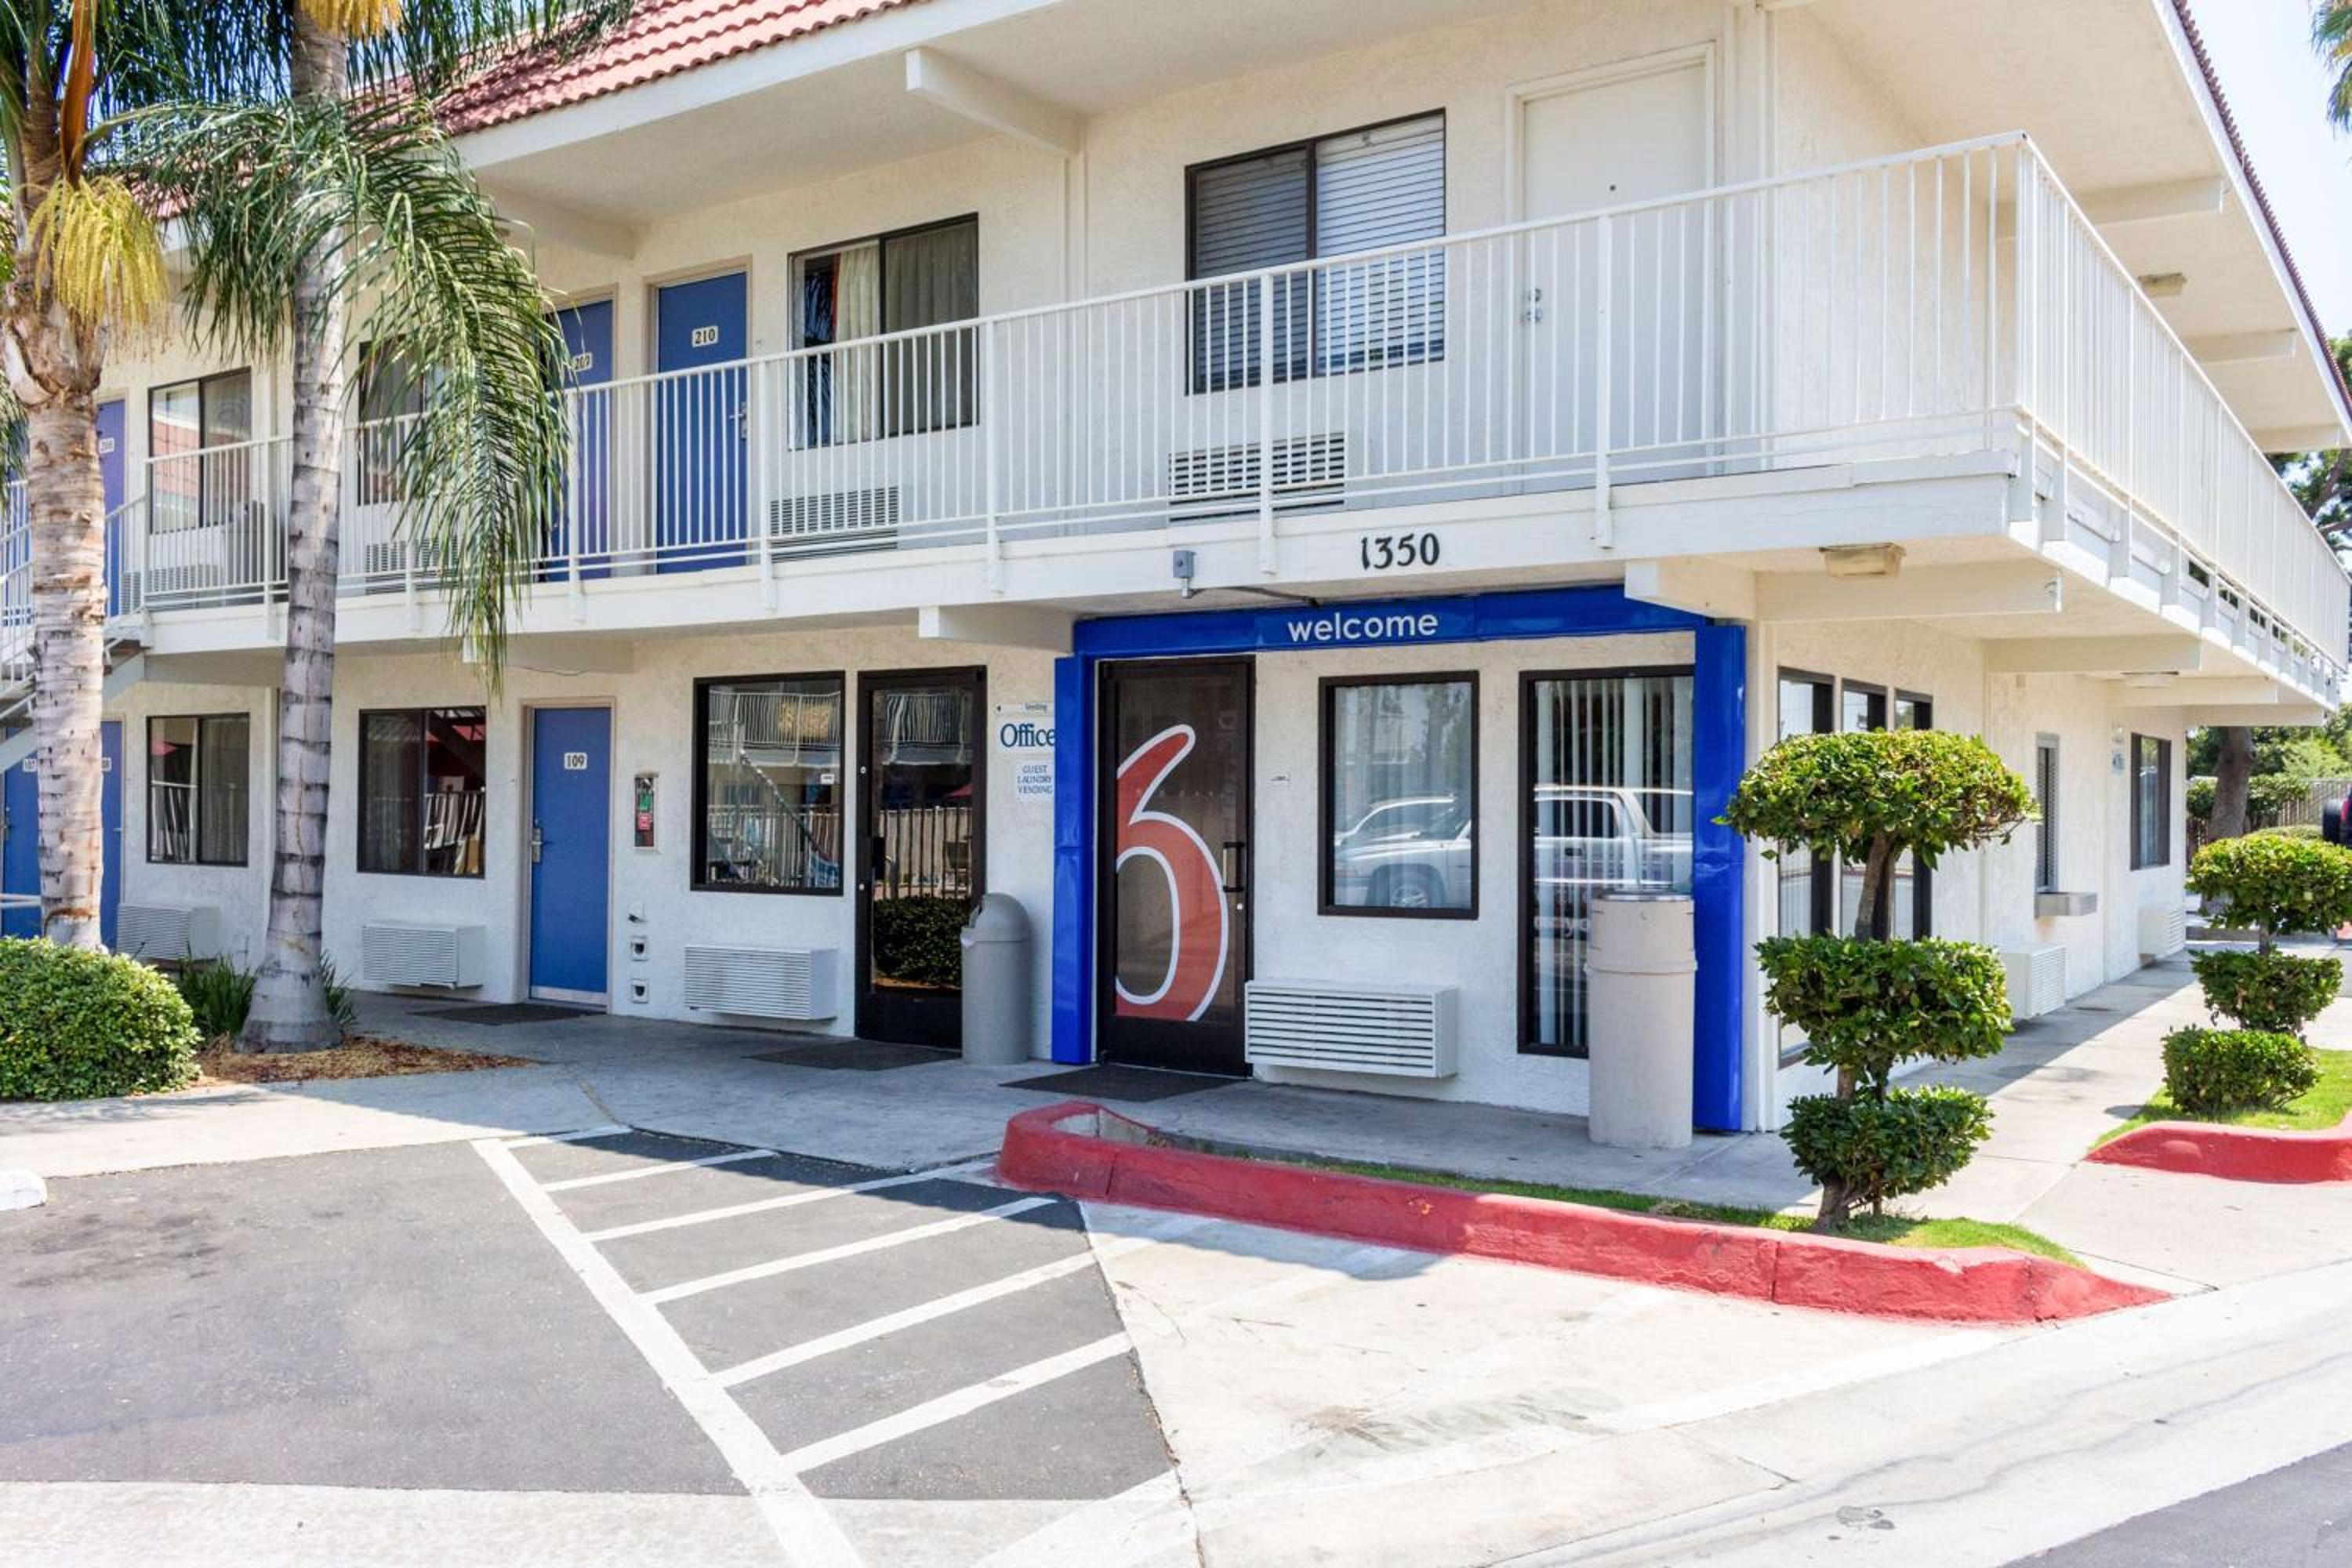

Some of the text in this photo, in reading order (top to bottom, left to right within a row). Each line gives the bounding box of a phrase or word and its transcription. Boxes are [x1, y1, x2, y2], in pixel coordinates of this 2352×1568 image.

[695, 328, 716, 344] 210
[1361, 532, 1440, 570] 1350
[1288, 610, 1439, 642] welcome
[1000, 723, 1055, 747] Office
[567, 754, 585, 767] 109
[1116, 724, 1229, 1022] 6
